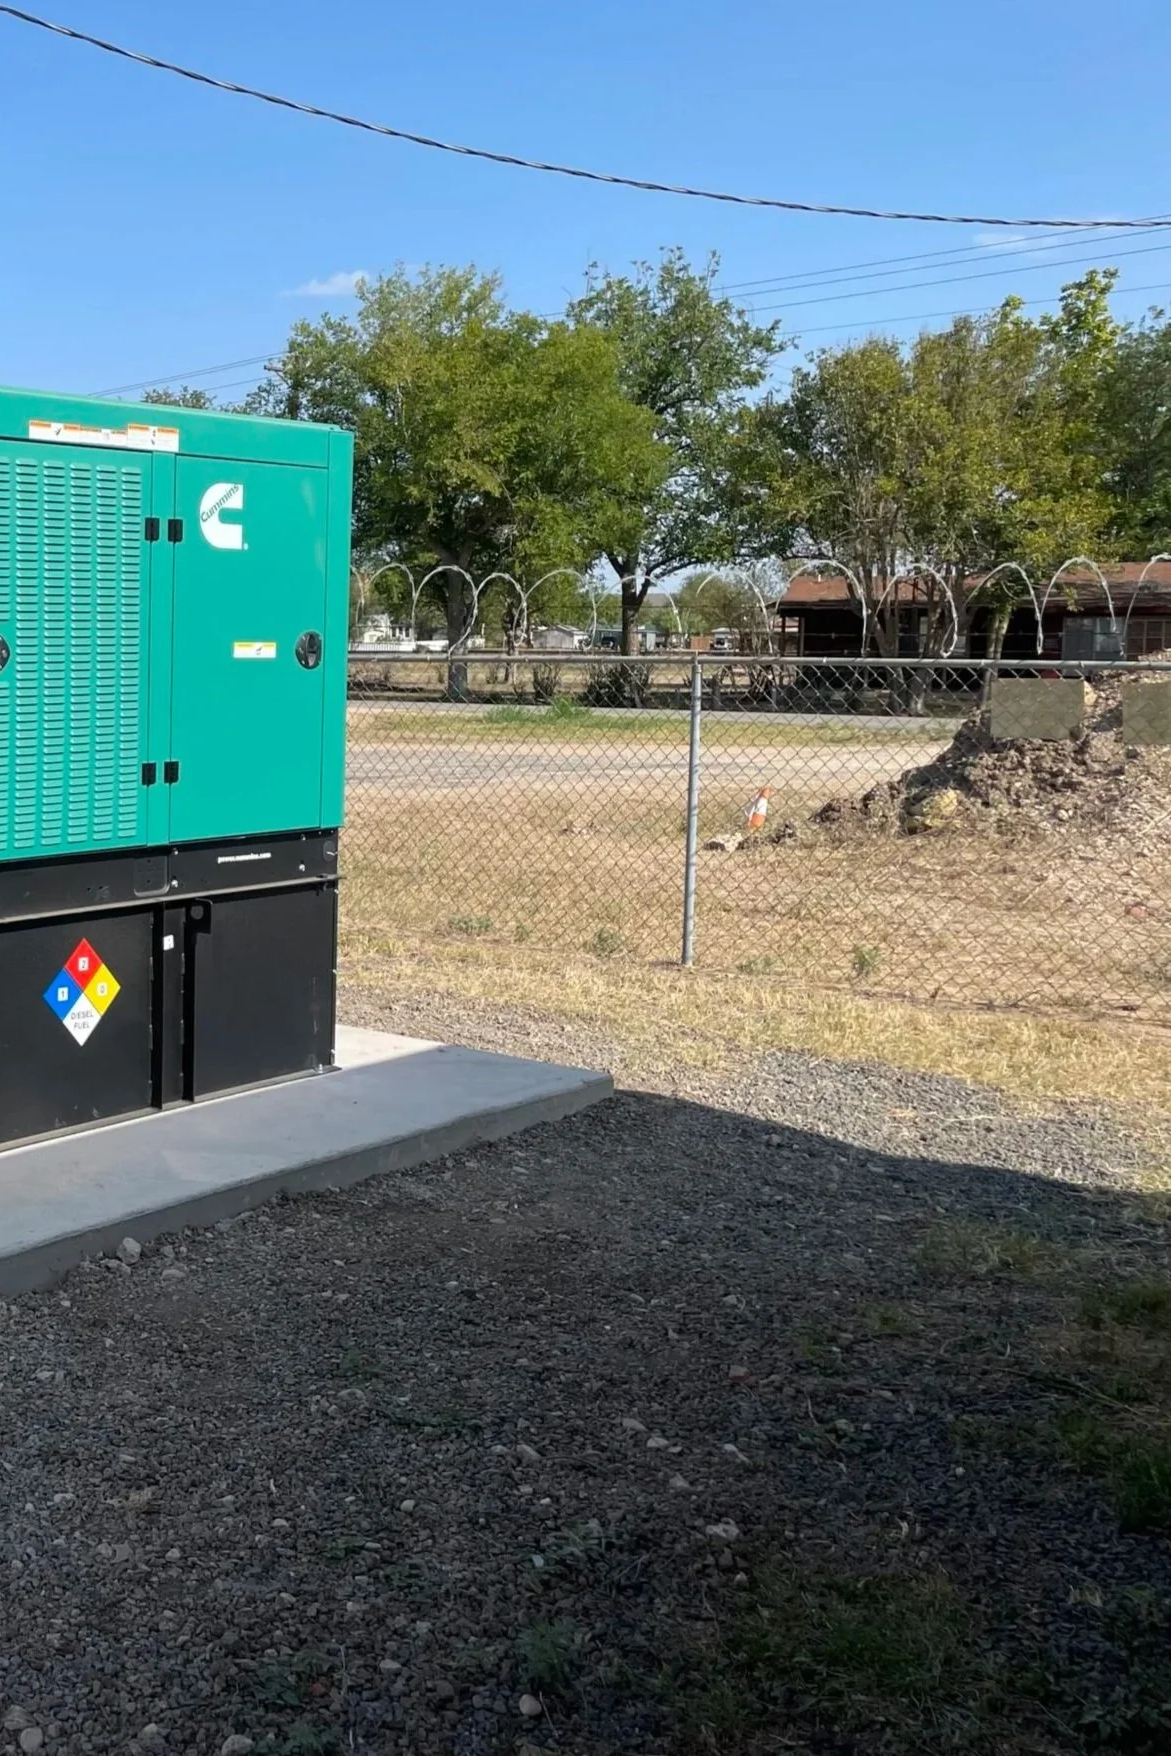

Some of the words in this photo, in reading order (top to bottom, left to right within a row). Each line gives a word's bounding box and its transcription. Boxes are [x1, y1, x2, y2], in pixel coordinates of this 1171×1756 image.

[200, 485, 240, 523] Cummins
[70, 1010, 95, 1020] DIESEL
[73, 1021, 91, 1030] FUEL
